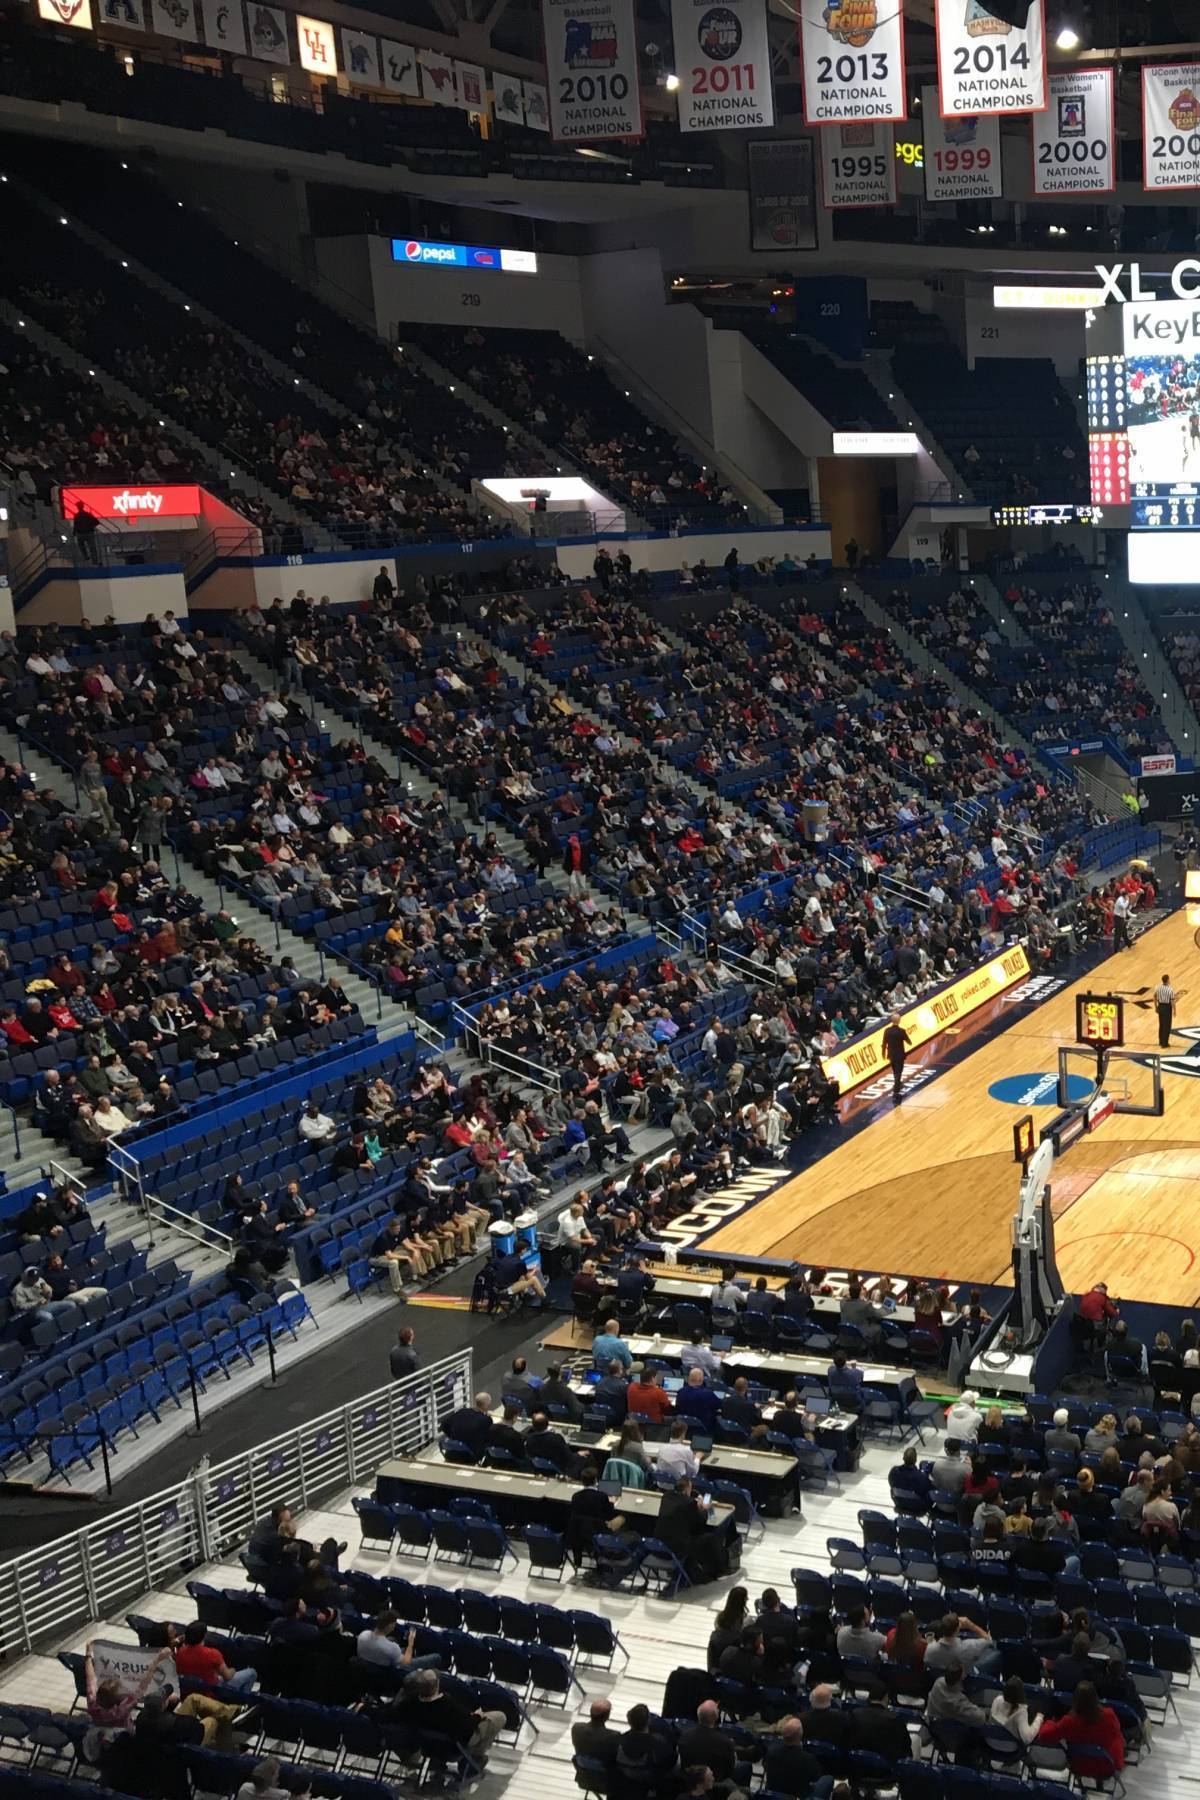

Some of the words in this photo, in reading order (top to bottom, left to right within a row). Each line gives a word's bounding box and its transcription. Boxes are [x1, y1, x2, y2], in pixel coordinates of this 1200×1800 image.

[953, 42, 1031, 74] 2014
[816, 53, 889, 84] 2013
[1151, 67, 1180, 77] UConn
[692, 64, 755, 94] 2011
[958, 77, 1028, 92] NATIONAL
[1067, 73, 1105, 82] Women's
[560, 74, 628, 103] 2010
[820, 87, 887, 101] NATIONAL
[693, 97, 757, 111] NATIONAL
[953, 94, 1034, 109] CHAMPIONS
[565, 107, 626, 120] NATIONAL
[816, 103, 893, 118] CHAMPIONS
[689, 114, 763, 128] CHAMPIONS
[562, 122, 632, 136] CHAMPIONS
[1038, 139, 1107, 164] 2000
[831, 155, 887, 177] 1995
[933, 149, 991, 172] 1999
[1046, 166, 1100, 177] NATIONAL
[835, 181, 886, 191] NATIONAL
[937, 174, 990, 185] NATIONAL
[1042, 179, 1105, 190] CHAMPIONS
[832, 193, 890, 204] CHAMPIONS
[934, 187, 995, 198] CHAMPIONS
[422, 248, 457, 261] pepsi
[1095, 263, 1156, 302] XL
[820, 304, 841, 316] 220
[981, 327, 1000, 338] 221
[112, 490, 163, 513] xfinity
[1143, 758, 1174, 771] ESPN
[1001, 950, 1025, 978] YOLKED
[1001, 976, 1055, 1001] UCONN
[931, 993, 958, 1022] YOLKED
[1087, 1017, 1113, 1040] 30
[845, 1043, 878, 1077] YOLKED
